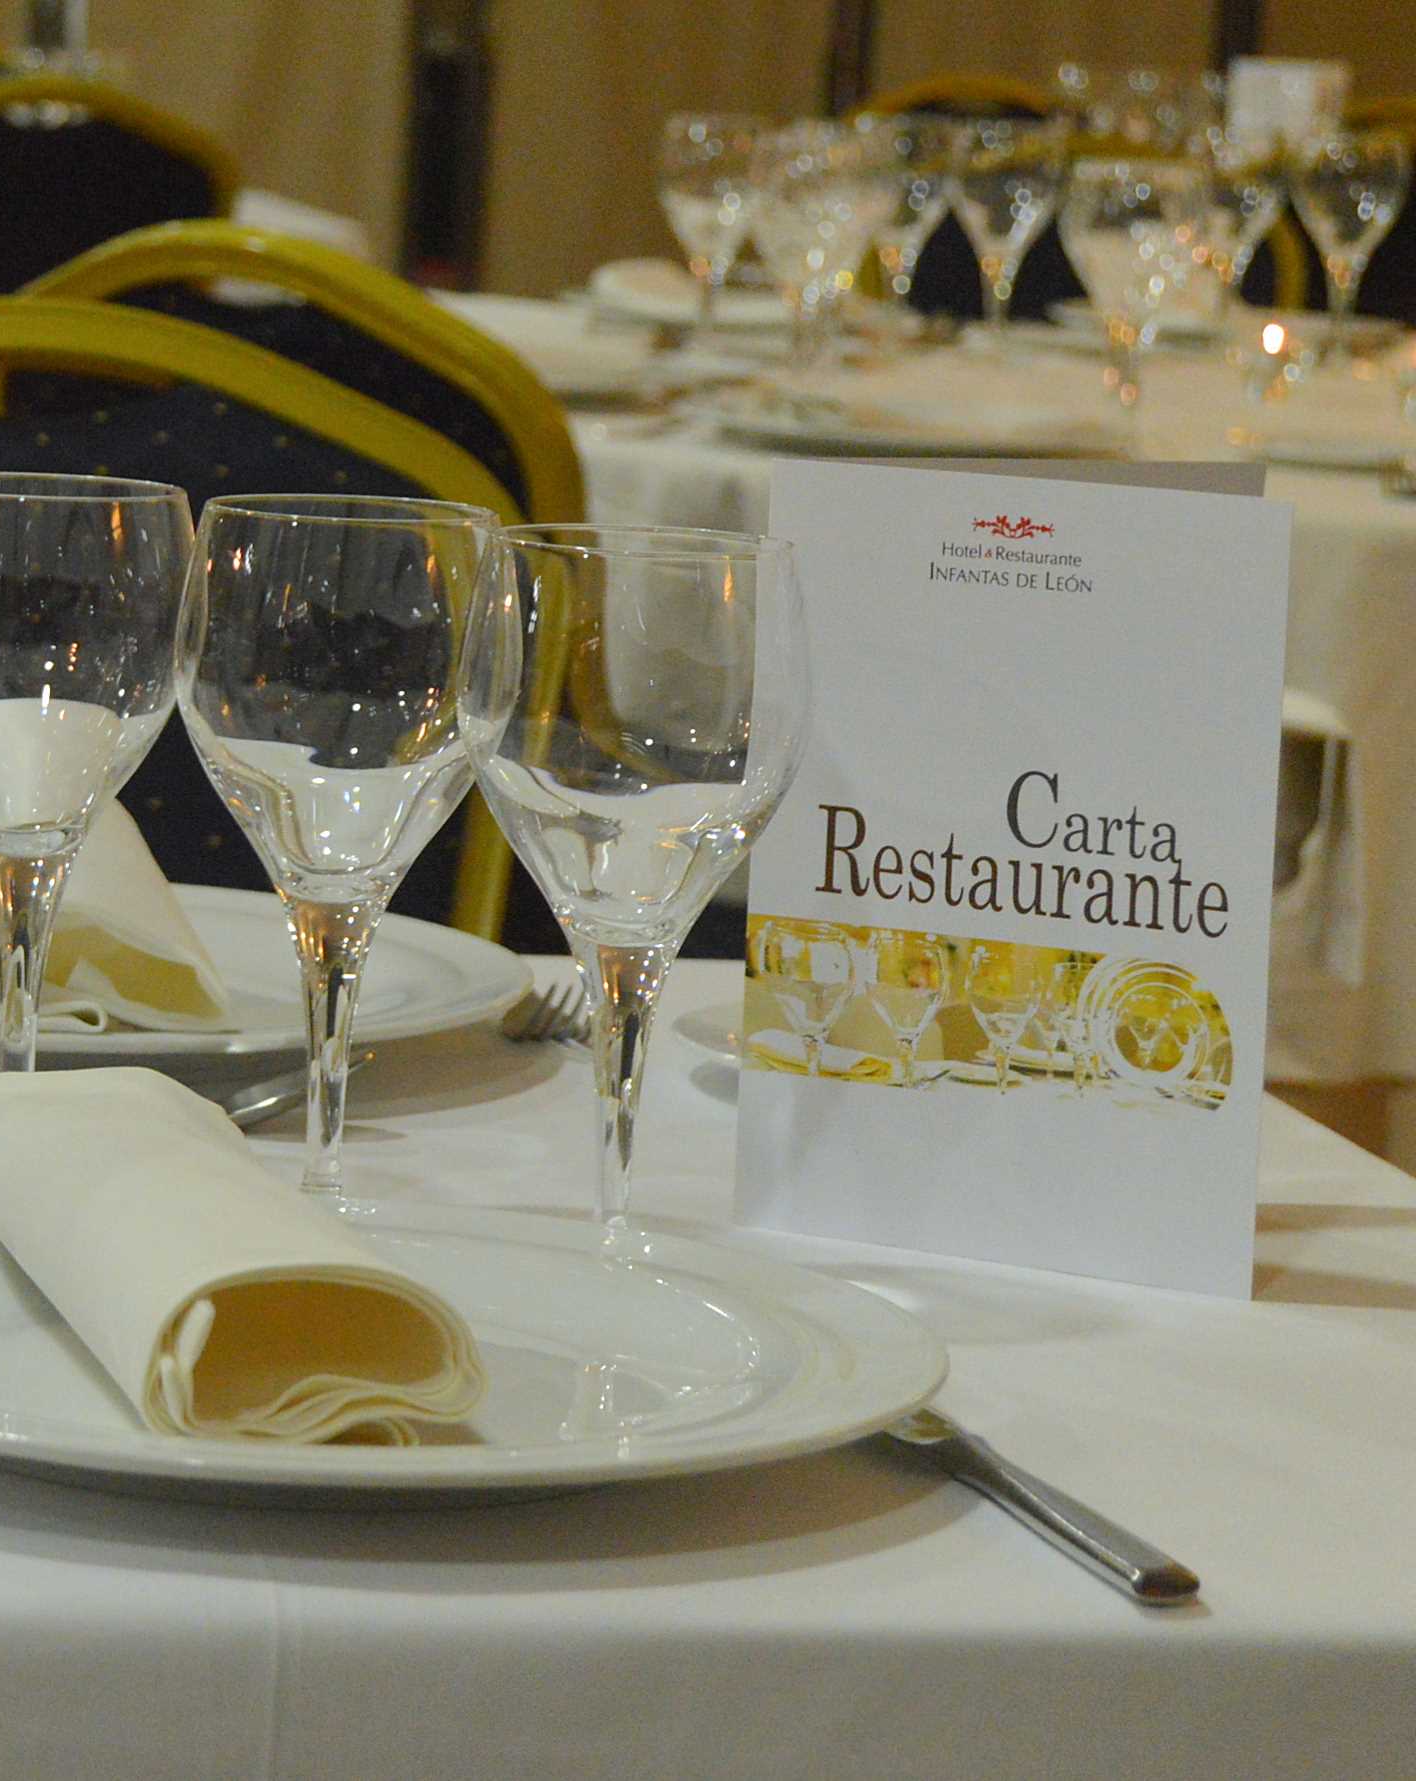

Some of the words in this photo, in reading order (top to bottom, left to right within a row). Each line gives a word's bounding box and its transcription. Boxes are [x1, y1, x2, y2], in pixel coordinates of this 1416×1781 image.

[929, 562, 1009, 587] INFANTAS
[1016, 572, 1038, 589] DE
[1045, 571, 1093, 593] LEÓN
[942, 541, 982, 559] Hotel
[995, 545, 1083, 567] Restaurante
[1006, 770, 1182, 863] Carta
[814, 803, 1229, 939] Restaurante
